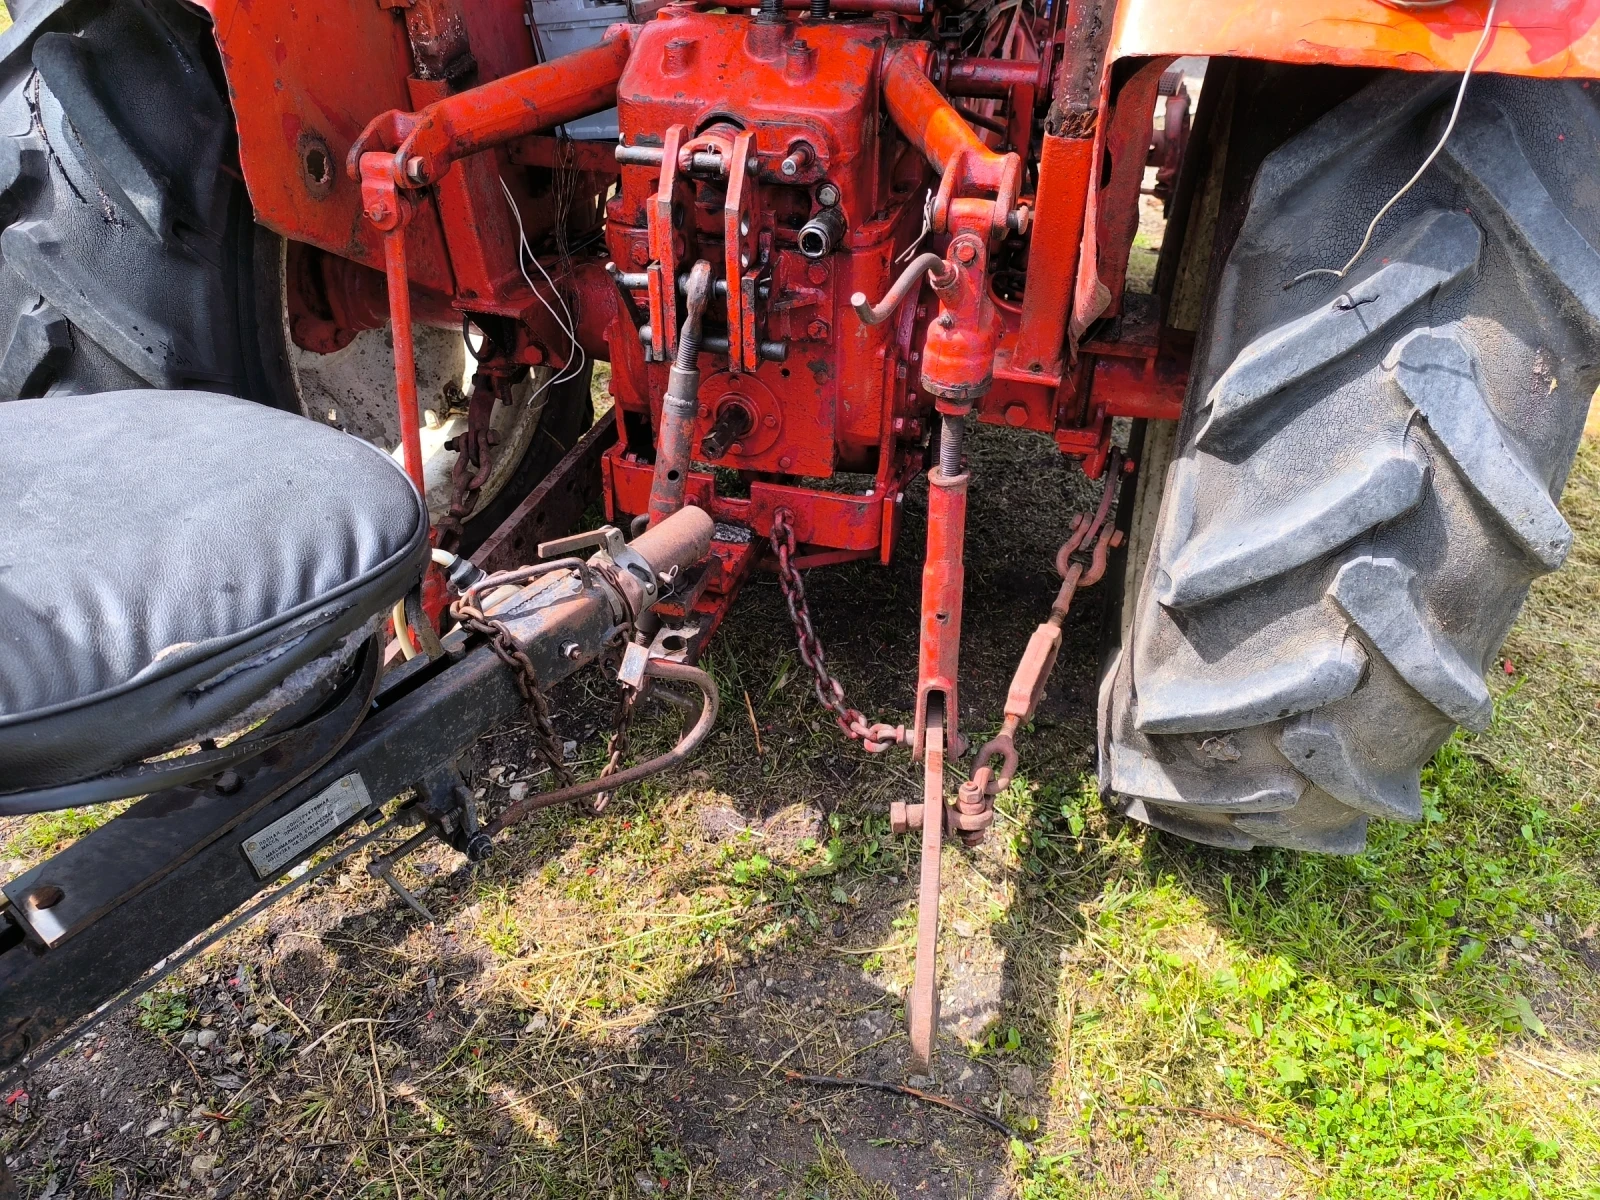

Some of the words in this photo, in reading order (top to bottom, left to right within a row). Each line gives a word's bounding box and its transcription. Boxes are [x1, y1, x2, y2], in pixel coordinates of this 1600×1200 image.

[261, 838, 280, 850] МАССА
[265, 832, 303, 858] МАКСИМАЛЬНАЯ
[304, 810, 334, 833] СТАТИЧЕСКАЯ
